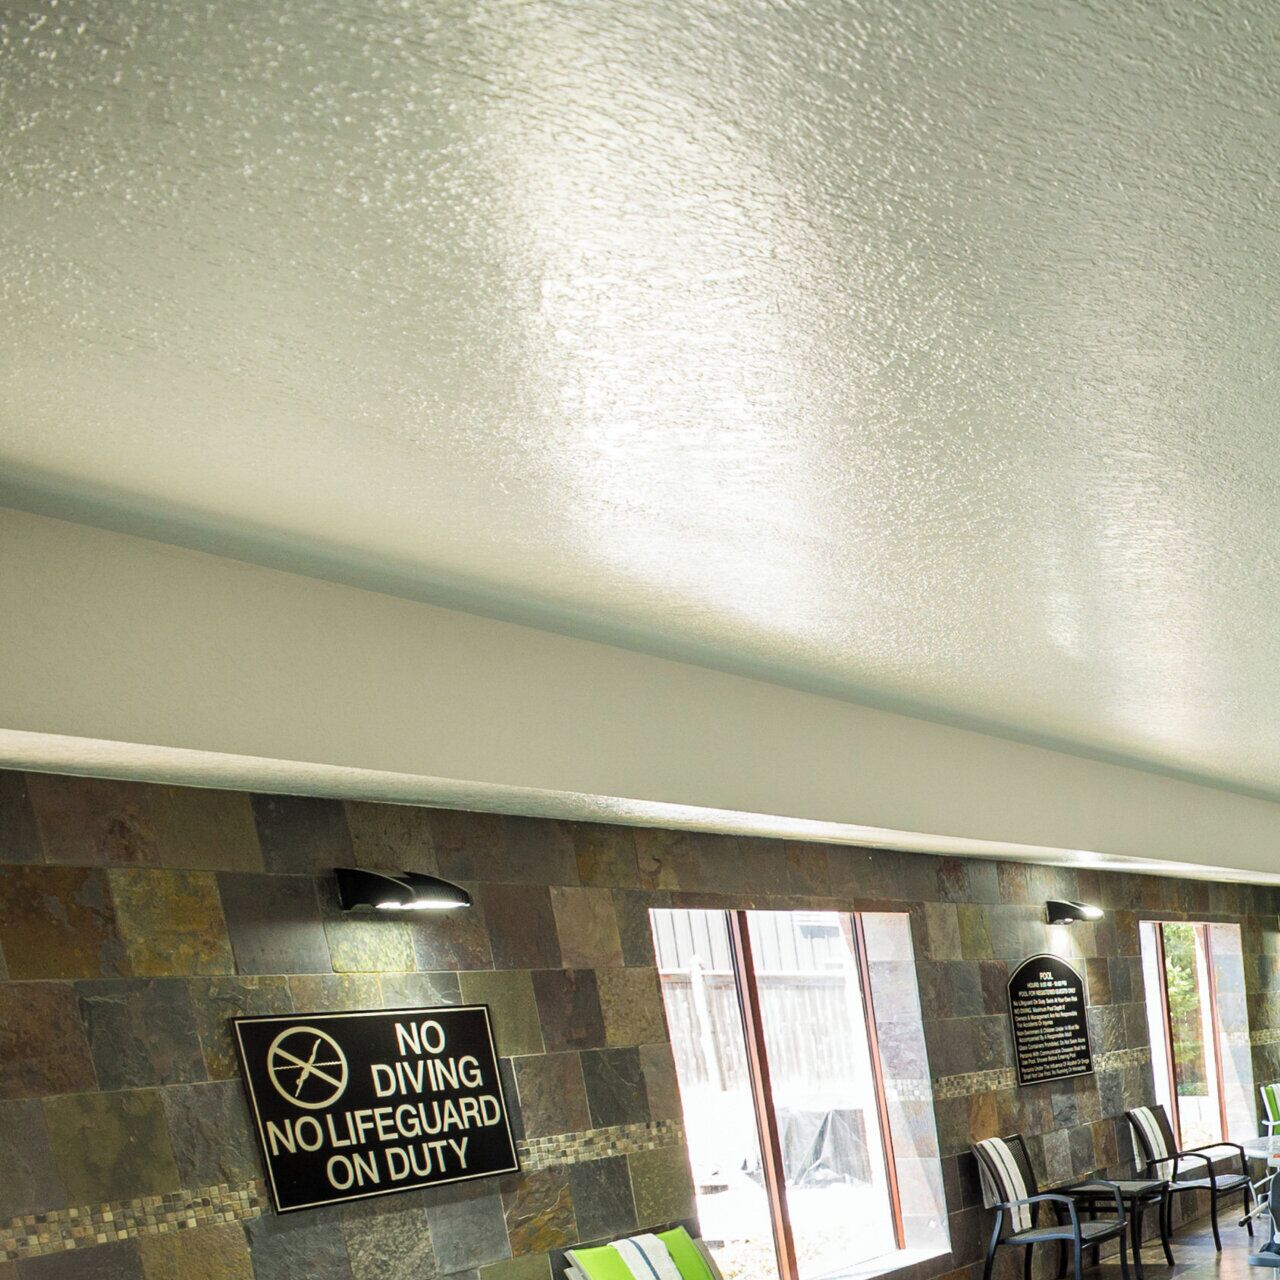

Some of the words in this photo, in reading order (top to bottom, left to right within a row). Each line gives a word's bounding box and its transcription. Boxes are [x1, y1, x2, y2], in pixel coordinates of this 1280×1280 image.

[1039, 972, 1054, 980] POOL
[395, 1020, 445, 1056] NO
[371, 1056, 483, 1098] DIVING
[266, 1116, 324, 1156] NO
[326, 1095, 500, 1148] LIFEGUARD
[326, 1153, 380, 1190] ON
[386, 1137, 468, 1180] DUTY
